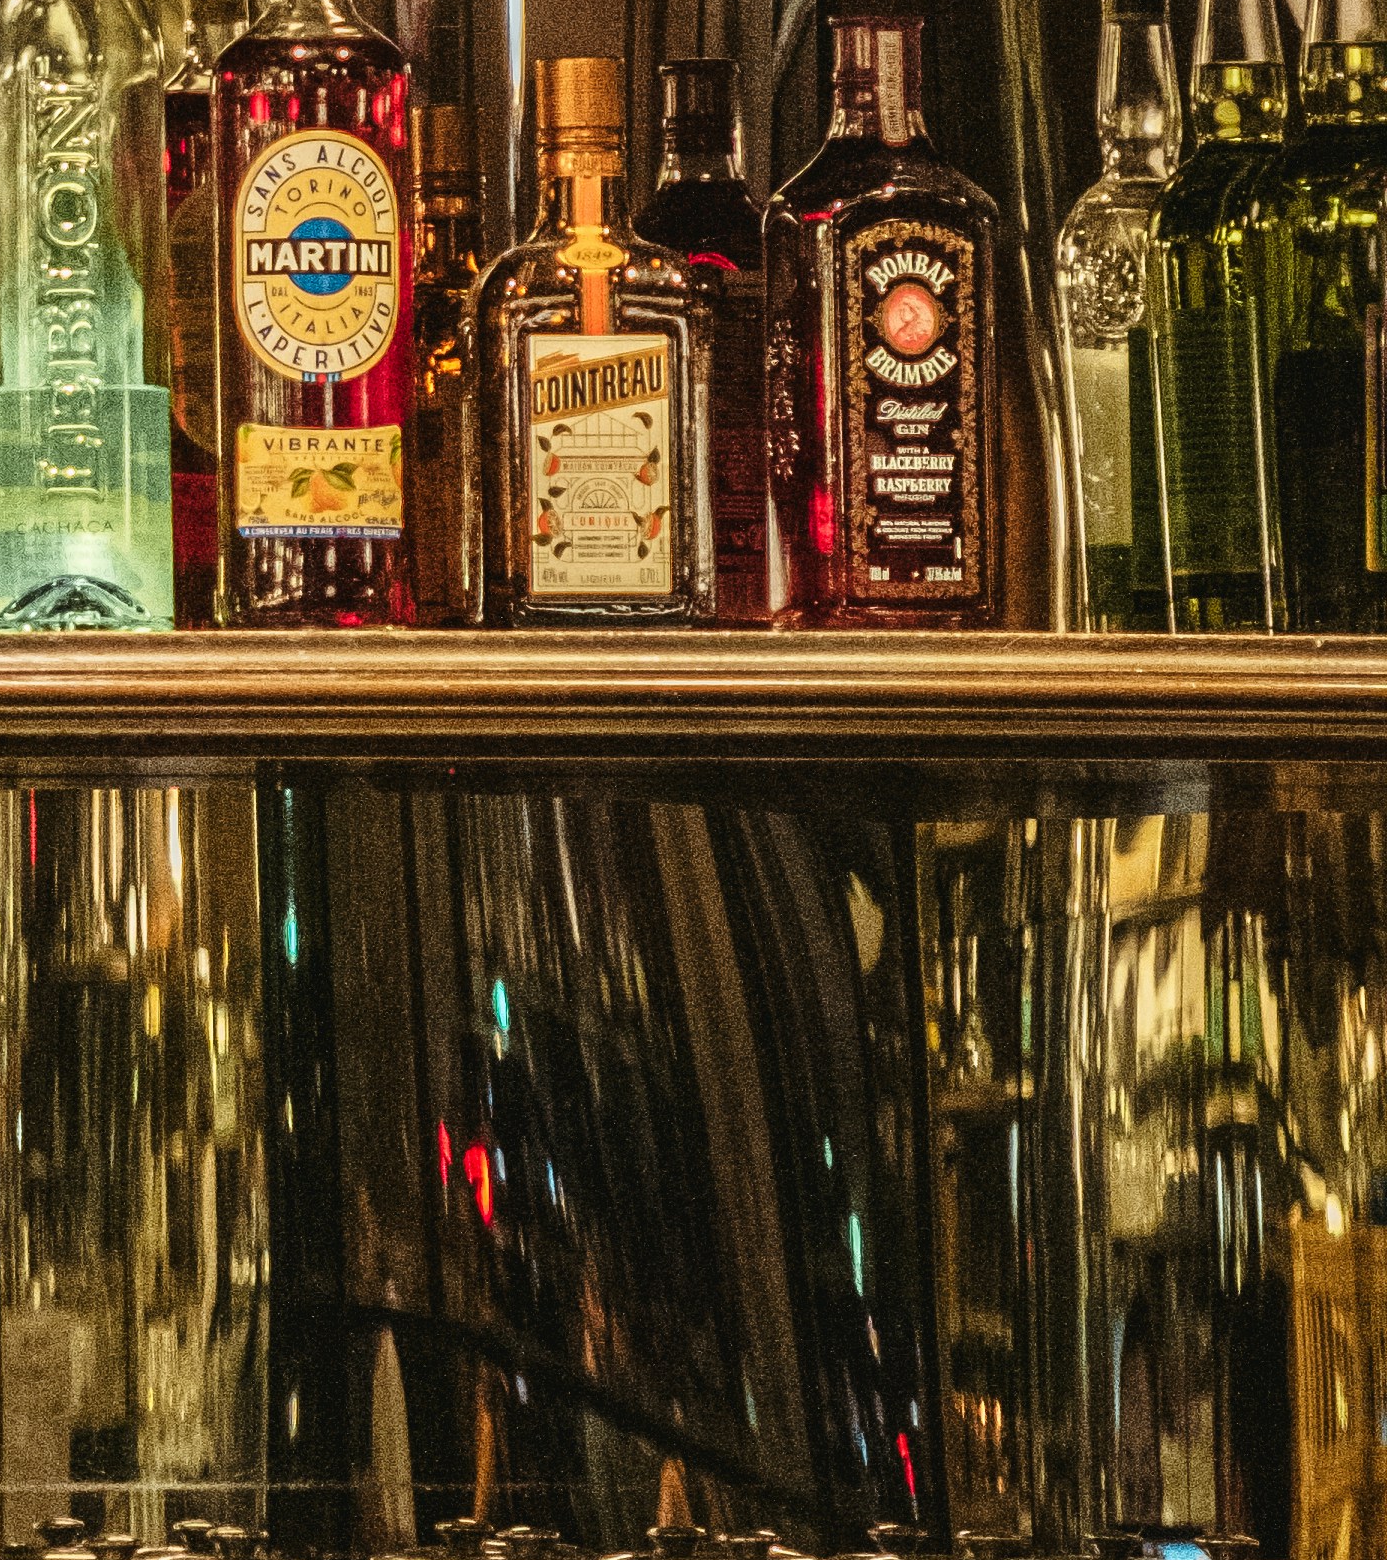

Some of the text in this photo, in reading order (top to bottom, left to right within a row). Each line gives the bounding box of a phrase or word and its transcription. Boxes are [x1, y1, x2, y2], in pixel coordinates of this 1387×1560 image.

[247, 144, 391, 220] SANS ALCOOL
[275, 178, 367, 217] TORINO
[250, 242, 388, 273] MARTINI
[868, 252, 955, 294] BOMBAY
[272, 286, 288, 297] DAL
[280, 303, 363, 334] ITALIA
[248, 302, 391, 369] L'APERITIVO
[868, 346, 958, 385] BRAMBLE
[534, 355, 664, 416] COINTREAU
[877, 400, 948, 420] Distilled
[895, 424, 930, 435] GIN
[264, 438, 384, 452] VIBRANTE
[872, 456, 955, 470] BLACKBERRY
[877, 478, 952, 492] RASPBERRY
[285, 508, 365, 524] SANS ALCOOL
[580, 574, 622, 584] LIQUEUR
